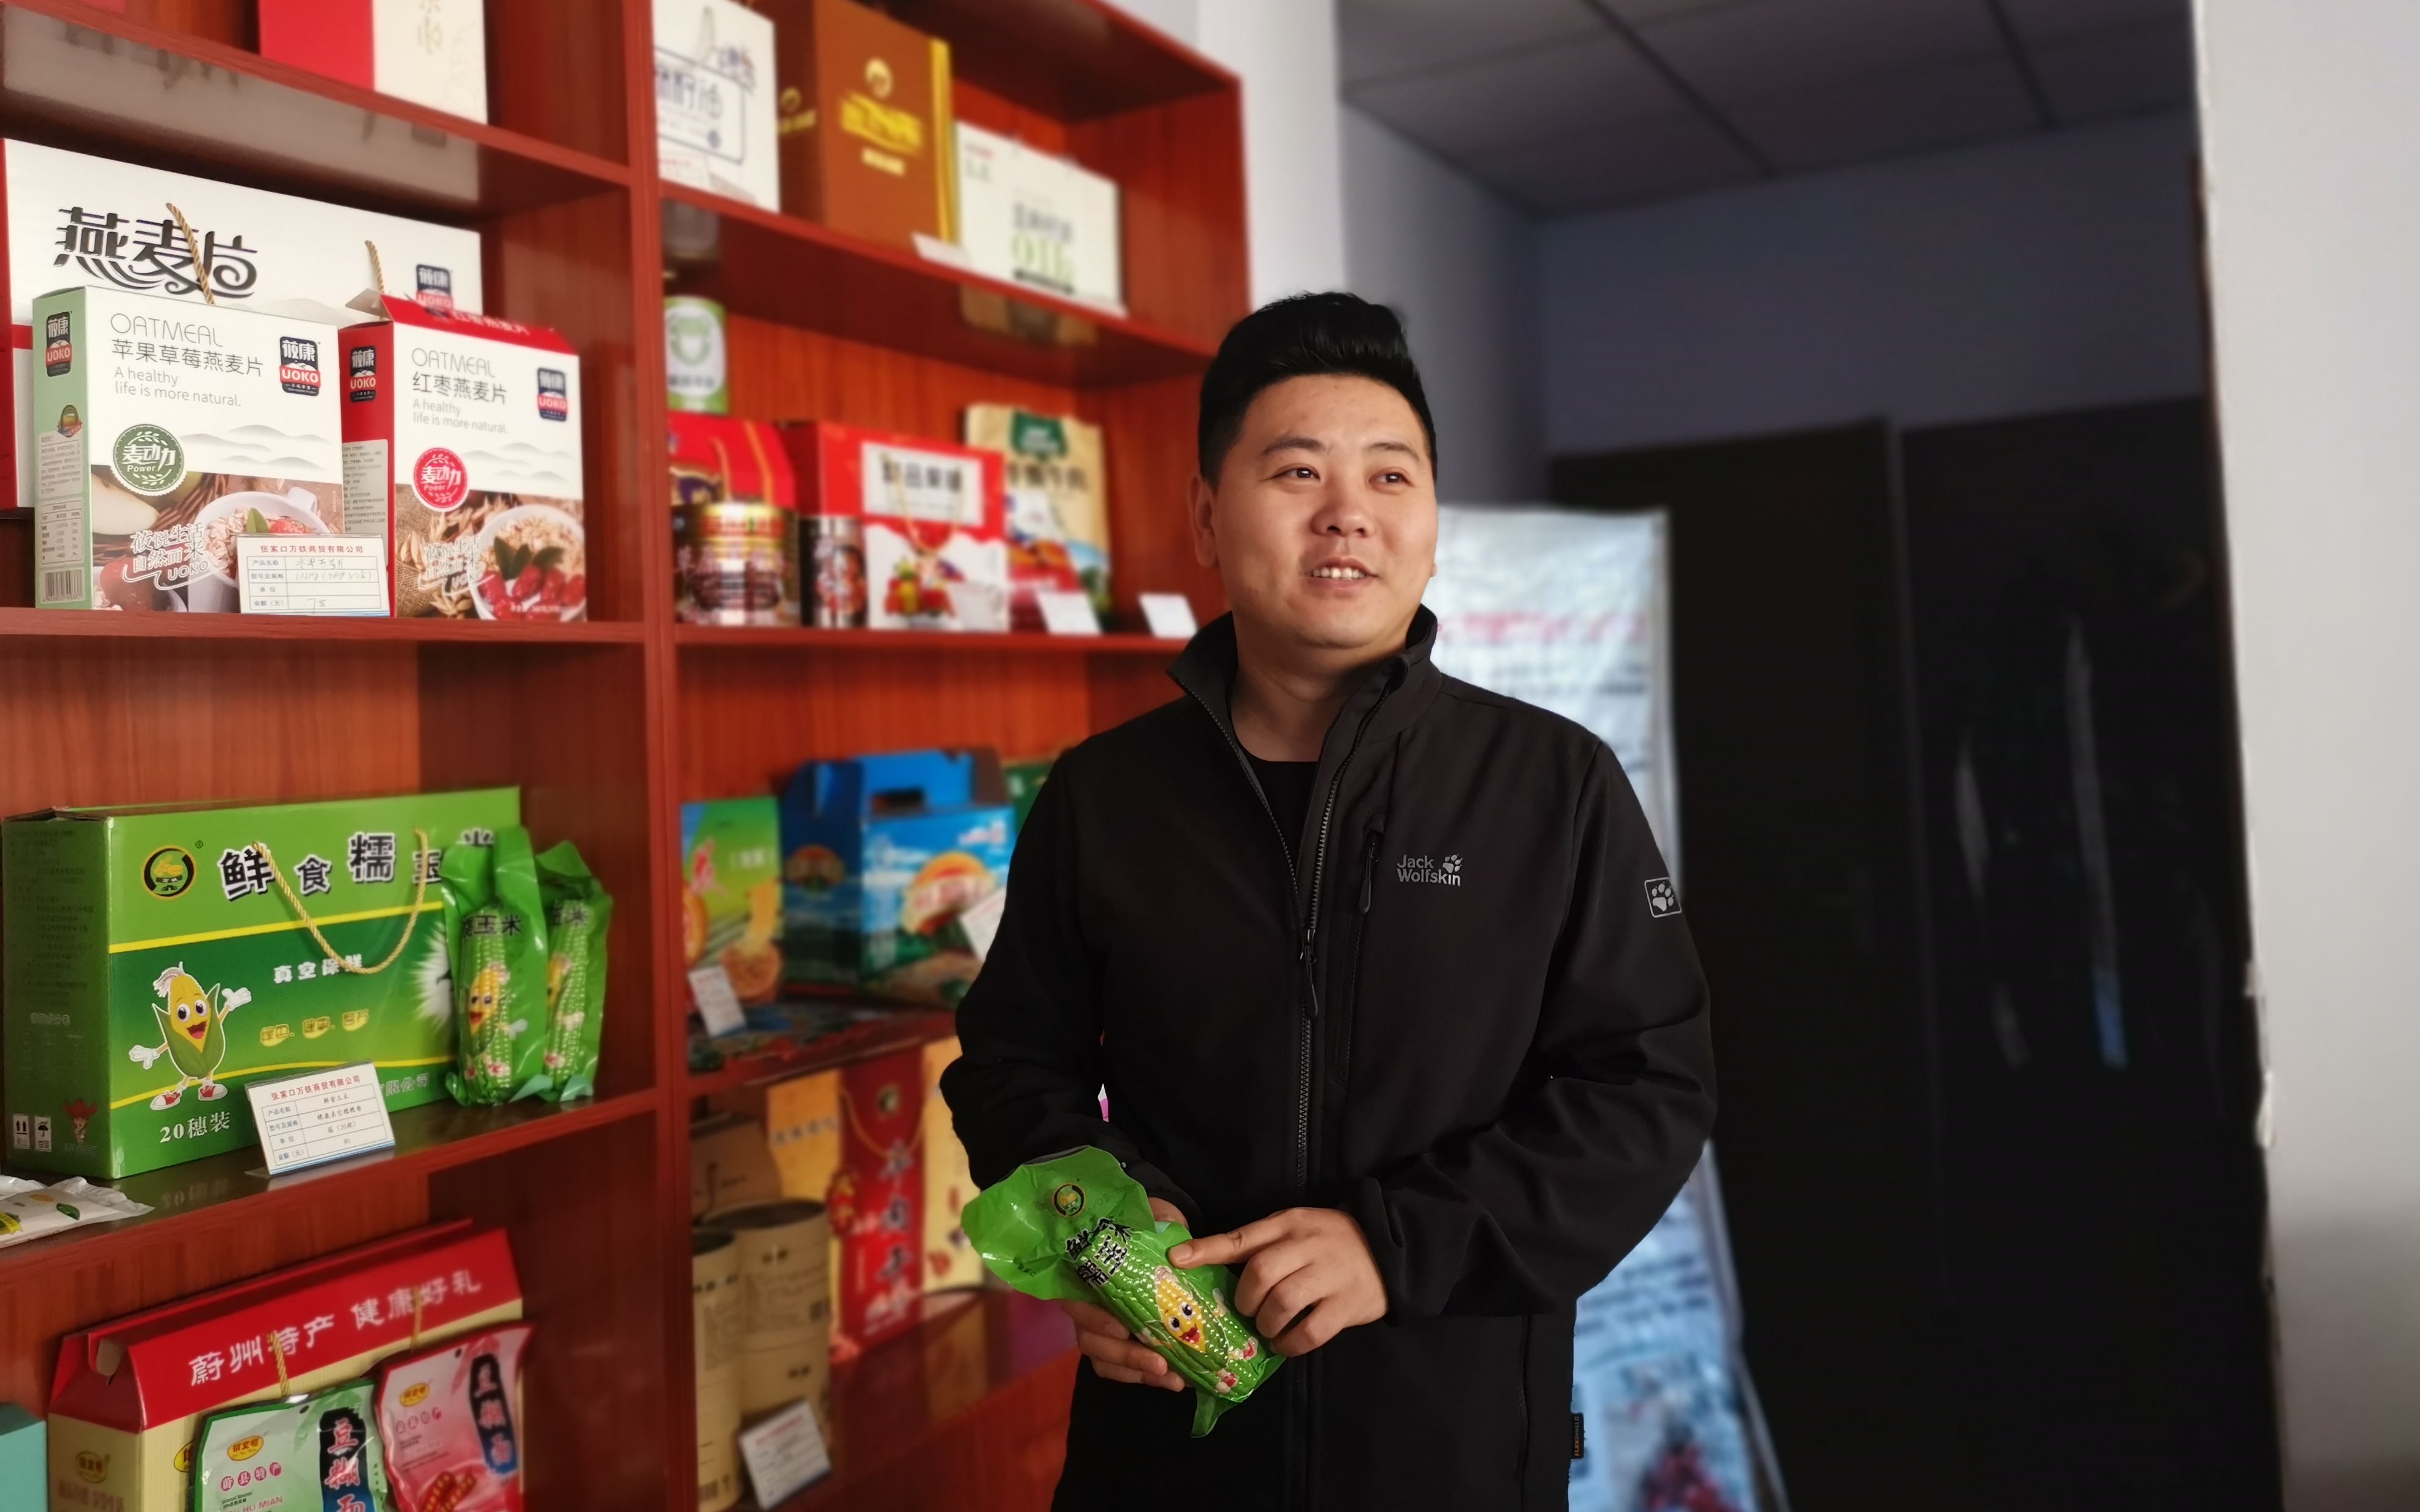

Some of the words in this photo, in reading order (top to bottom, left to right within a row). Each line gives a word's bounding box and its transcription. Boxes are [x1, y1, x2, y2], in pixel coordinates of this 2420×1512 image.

[53, 206, 258, 299] 燕麦片
[110, 313, 223, 347] OATMEAL
[111, 338, 263, 377] 苹果草莓燕麦片
[412, 348, 496, 378] OATMEAL
[115, 367, 124, 378] A
[127, 367, 179, 387] healthy
[282, 369, 319, 383] UOKO
[350, 377, 376, 390] UOKO
[412, 371, 507, 405] 红枣燕麦片
[115, 380, 137, 396] life
[140, 385, 151, 397] is
[155, 388, 190, 401] more
[193, 388, 242, 407] natural.
[413, 398, 420, 409] A
[423, 398, 462, 417] healthy
[413, 412, 429, 424] life
[432, 414, 440, 426] is
[443, 417, 470, 428] more
[471, 418, 508, 433] natural.
[122, 443, 176, 472] 麦动力
[420, 465, 462, 490] 麦动力
[260, 545, 363, 554] 张家口万铁商贸有限公司
[168, 560, 209, 581] UOKO
[1397, 854, 1434, 869] Jack
[1397, 868, 1461, 886] Wolfskin
[274, 954, 363, 984] 真空保鲜
[271, 1075, 360, 1101] 张家口万铁商贸有限公司
[268, 1106, 292, 1116] 产品名称
[160, 1111, 231, 1143] 20穗装
[188, 1313, 335, 1386] 蔚州特产
[351, 1270, 482, 1331] 健康好礼
[259, 1496, 283, 1510] MIAN
